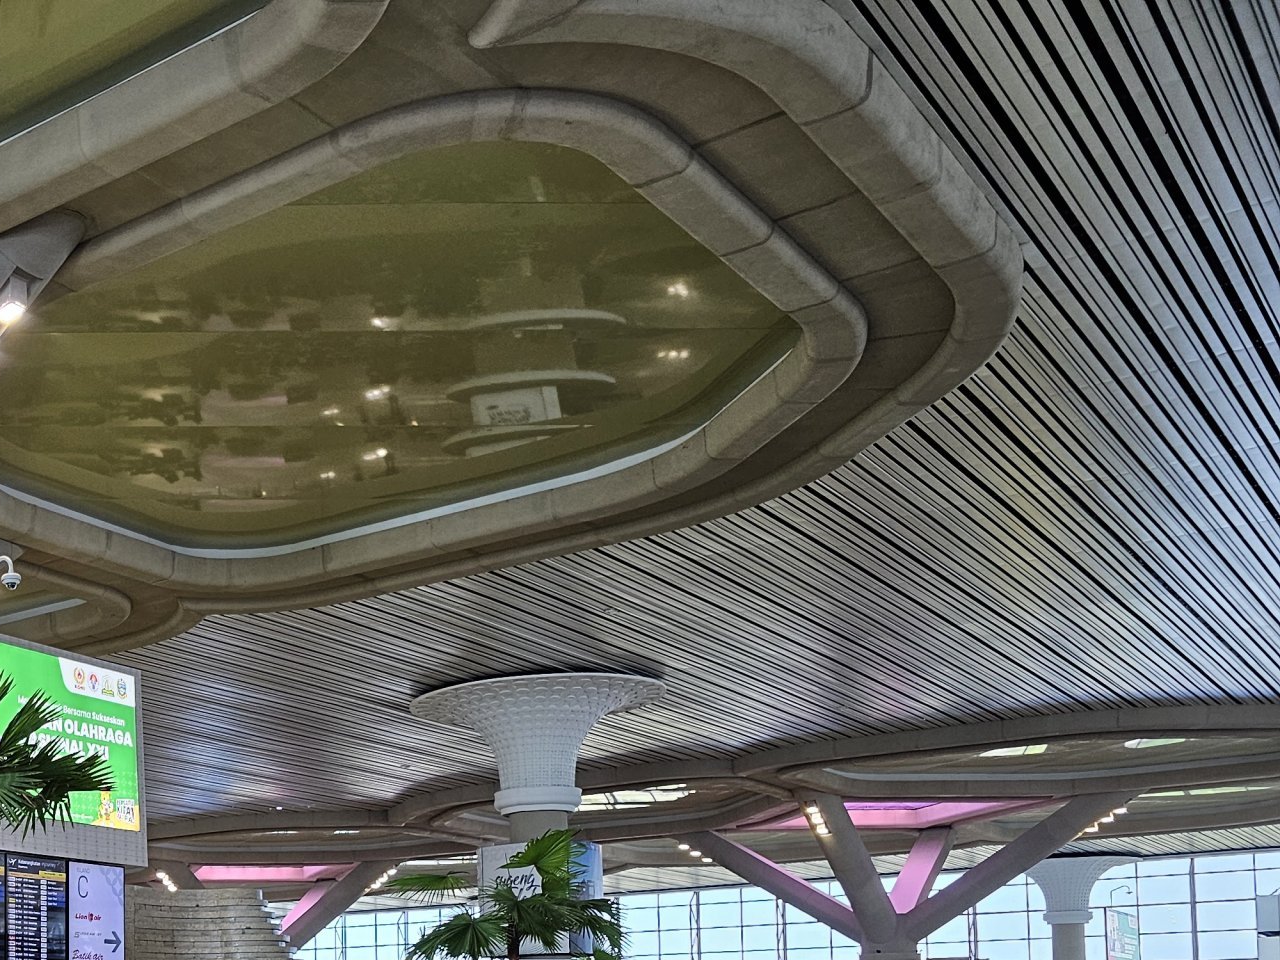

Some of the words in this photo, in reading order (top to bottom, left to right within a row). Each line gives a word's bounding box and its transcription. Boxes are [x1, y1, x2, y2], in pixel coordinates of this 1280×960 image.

[63, 705, 91, 718] Bersama
[91, 710, 125, 727] Sukseskan
[64, 719, 134, 748] OLAHRAGA
[77, 875, 89, 898] C
[75, 912, 88, 920] Lion
[72, 949, 92, 960] Batik
[92, 952, 104, 960] air
